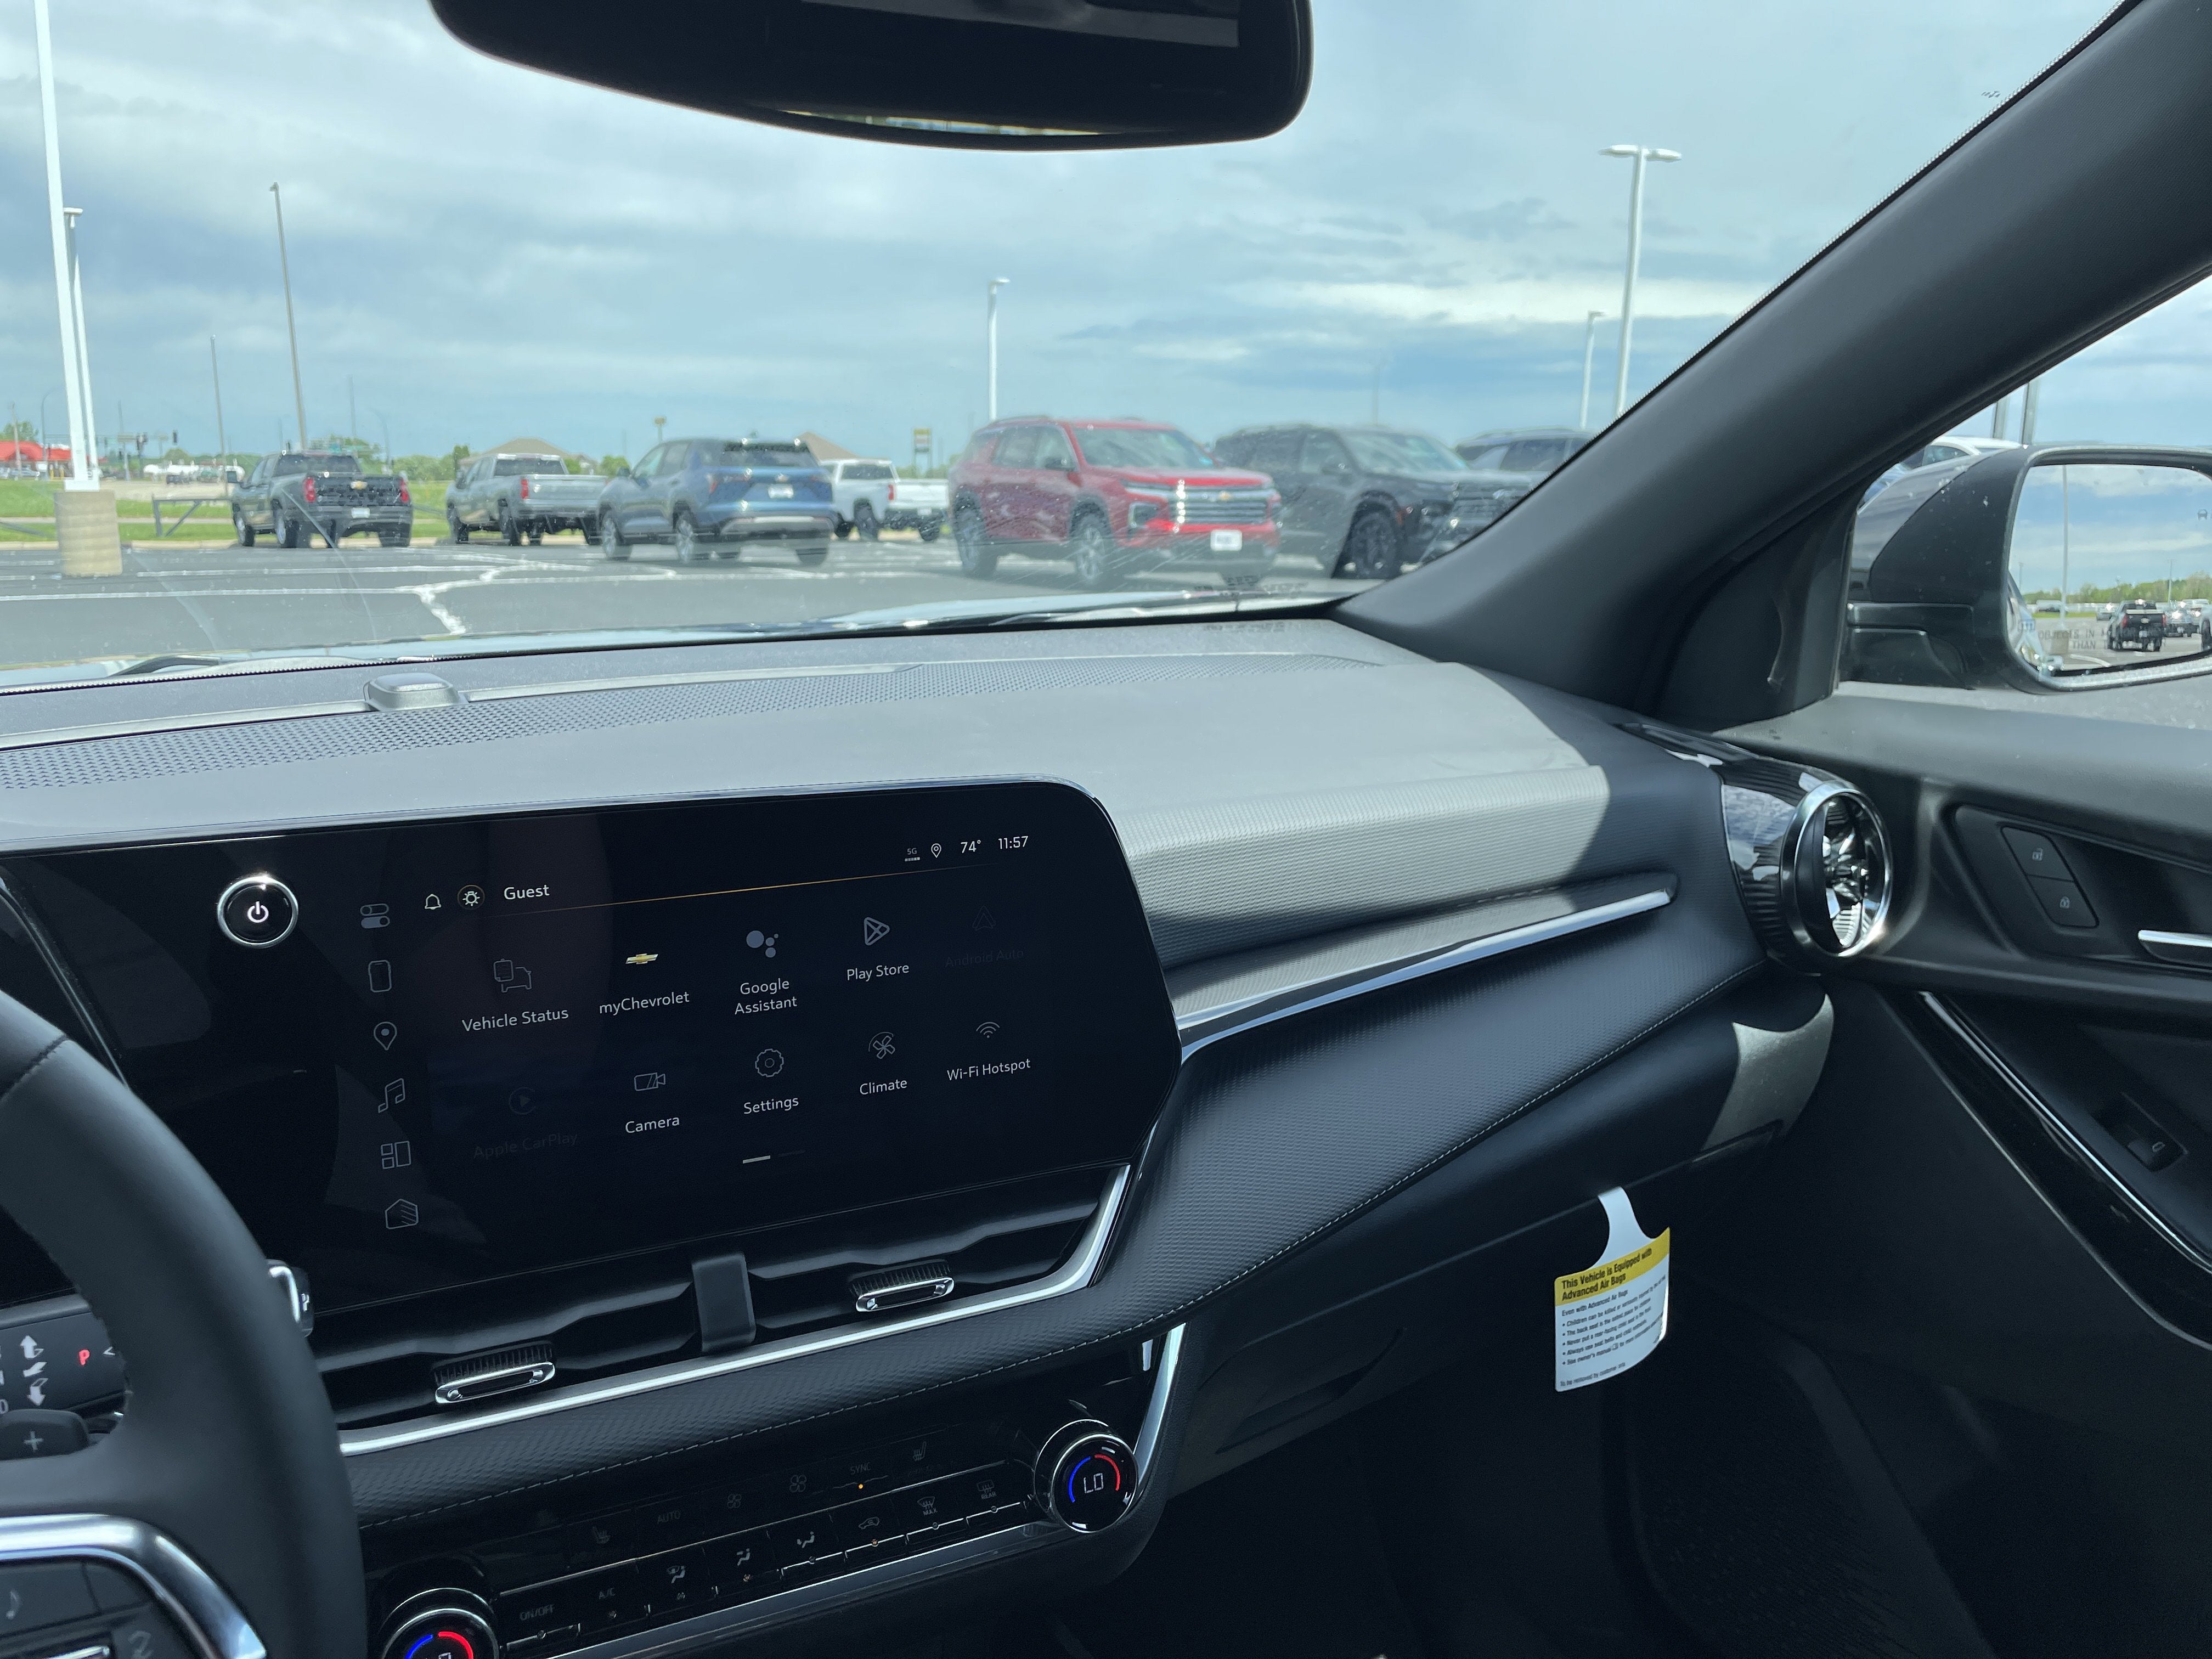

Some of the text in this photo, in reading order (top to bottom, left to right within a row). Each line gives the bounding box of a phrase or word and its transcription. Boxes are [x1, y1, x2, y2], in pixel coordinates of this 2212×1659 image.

[998, 836, 1029, 850] 11:57
[504, 884, 550, 900] Guest
[945, 950, 1024, 968] Android Auto
[847, 964, 910, 982] Play Store
[740, 978, 790, 995] Google
[599, 991, 690, 1015] myChevrolet
[734, 996, 798, 1015] Assistant
[461, 1008, 569, 1031] Vehicle Status
[946, 1058, 1031, 1081] Wi-Fi Hotspot
[859, 1078, 908, 1096] Climate
[743, 1097, 799, 1115] Settings
[625, 1116, 680, 1134] Camera
[473, 1132, 578, 1160] Apple CarPlay
[1561, 1278, 1578, 1289] This
[1580, 1269, 1605, 1284] Vehicle
[1606, 1266, 1612, 1276] is
[1613, 1253, 1640, 1273] Equipped
[1561, 1273, 1626, 1301] Advanced Air Bags
[78, 1349, 90, 1365] P
[850, 1461, 871, 1476] SYNC
[657, 1509, 681, 1525] AUTO
[922, 1507, 938, 1516] MAX
[599, 1587, 616, 1600] A/C
[519, 1604, 555, 1622] ON/OFF
